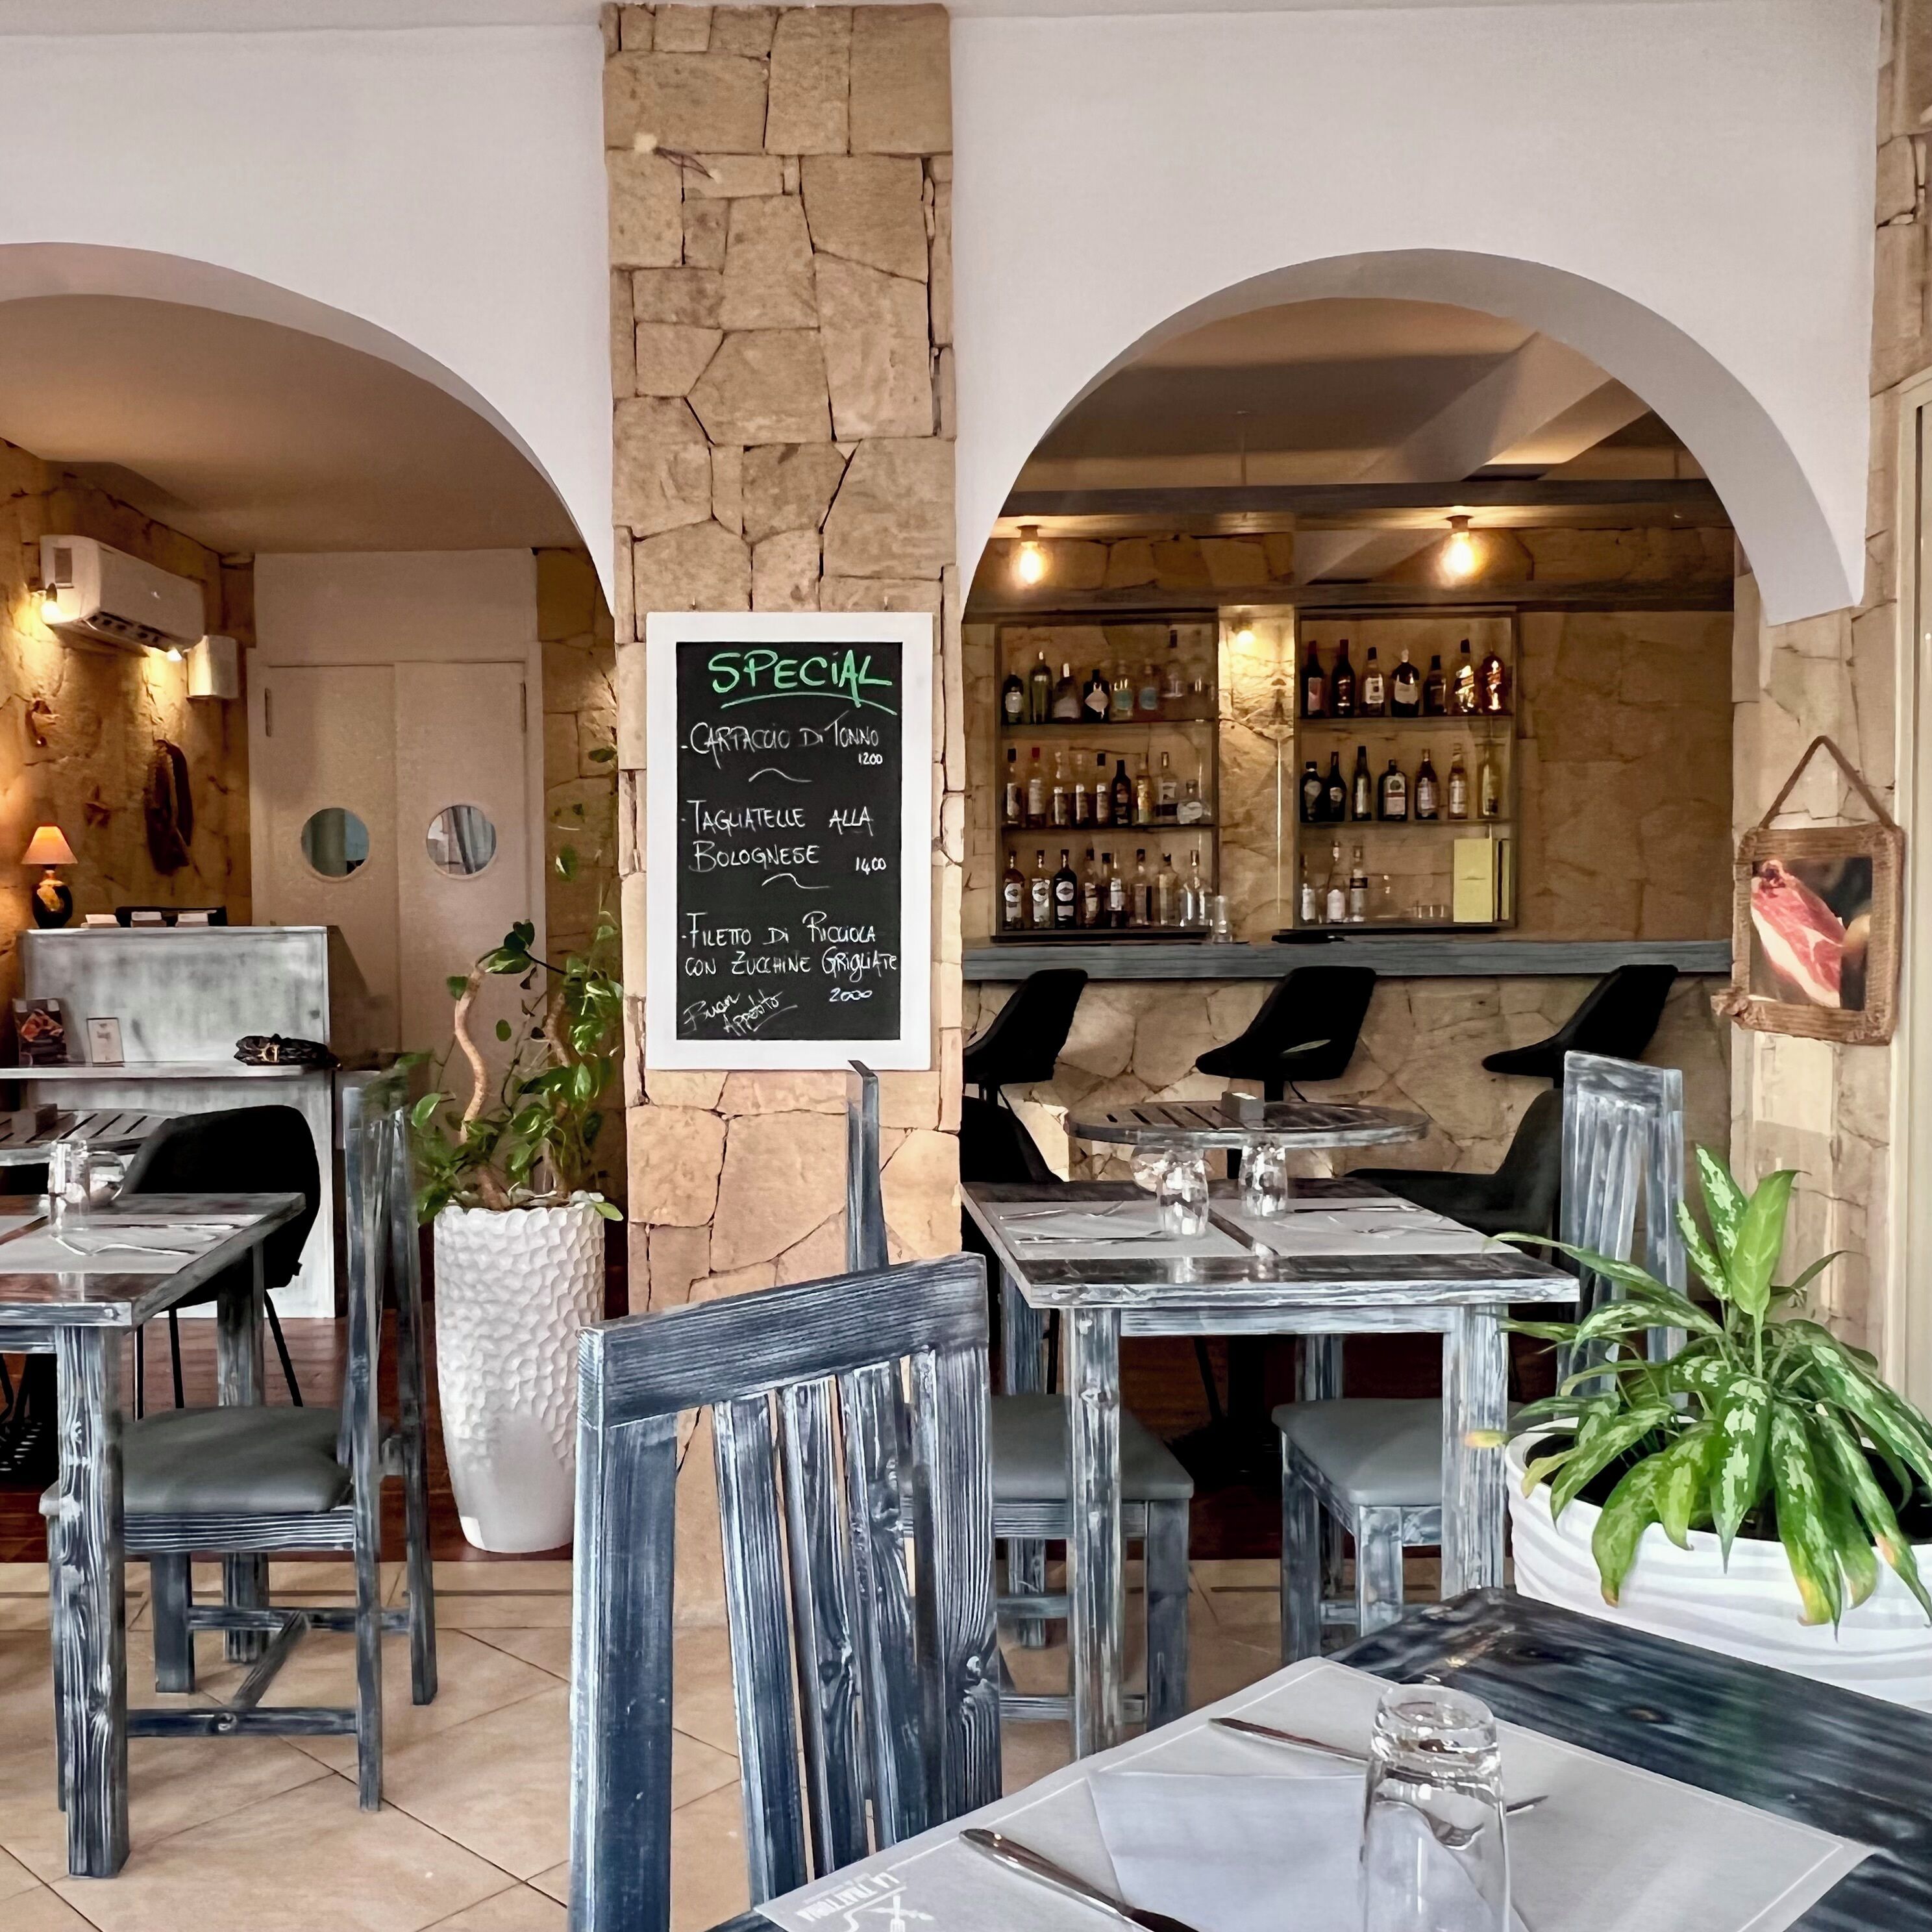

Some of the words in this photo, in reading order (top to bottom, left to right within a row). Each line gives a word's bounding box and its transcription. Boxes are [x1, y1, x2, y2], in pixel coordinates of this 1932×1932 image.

[858, 752, 884, 765] 1200
[828, 806, 874, 836] ALLA
[688, 840, 820, 873] BOLOGNESE
[855, 856, 887, 875] 1400
[685, 957, 717, 976] CON
[731, 950, 811, 975] ZUCCHINE
[828, 987, 873, 1002] 2000
